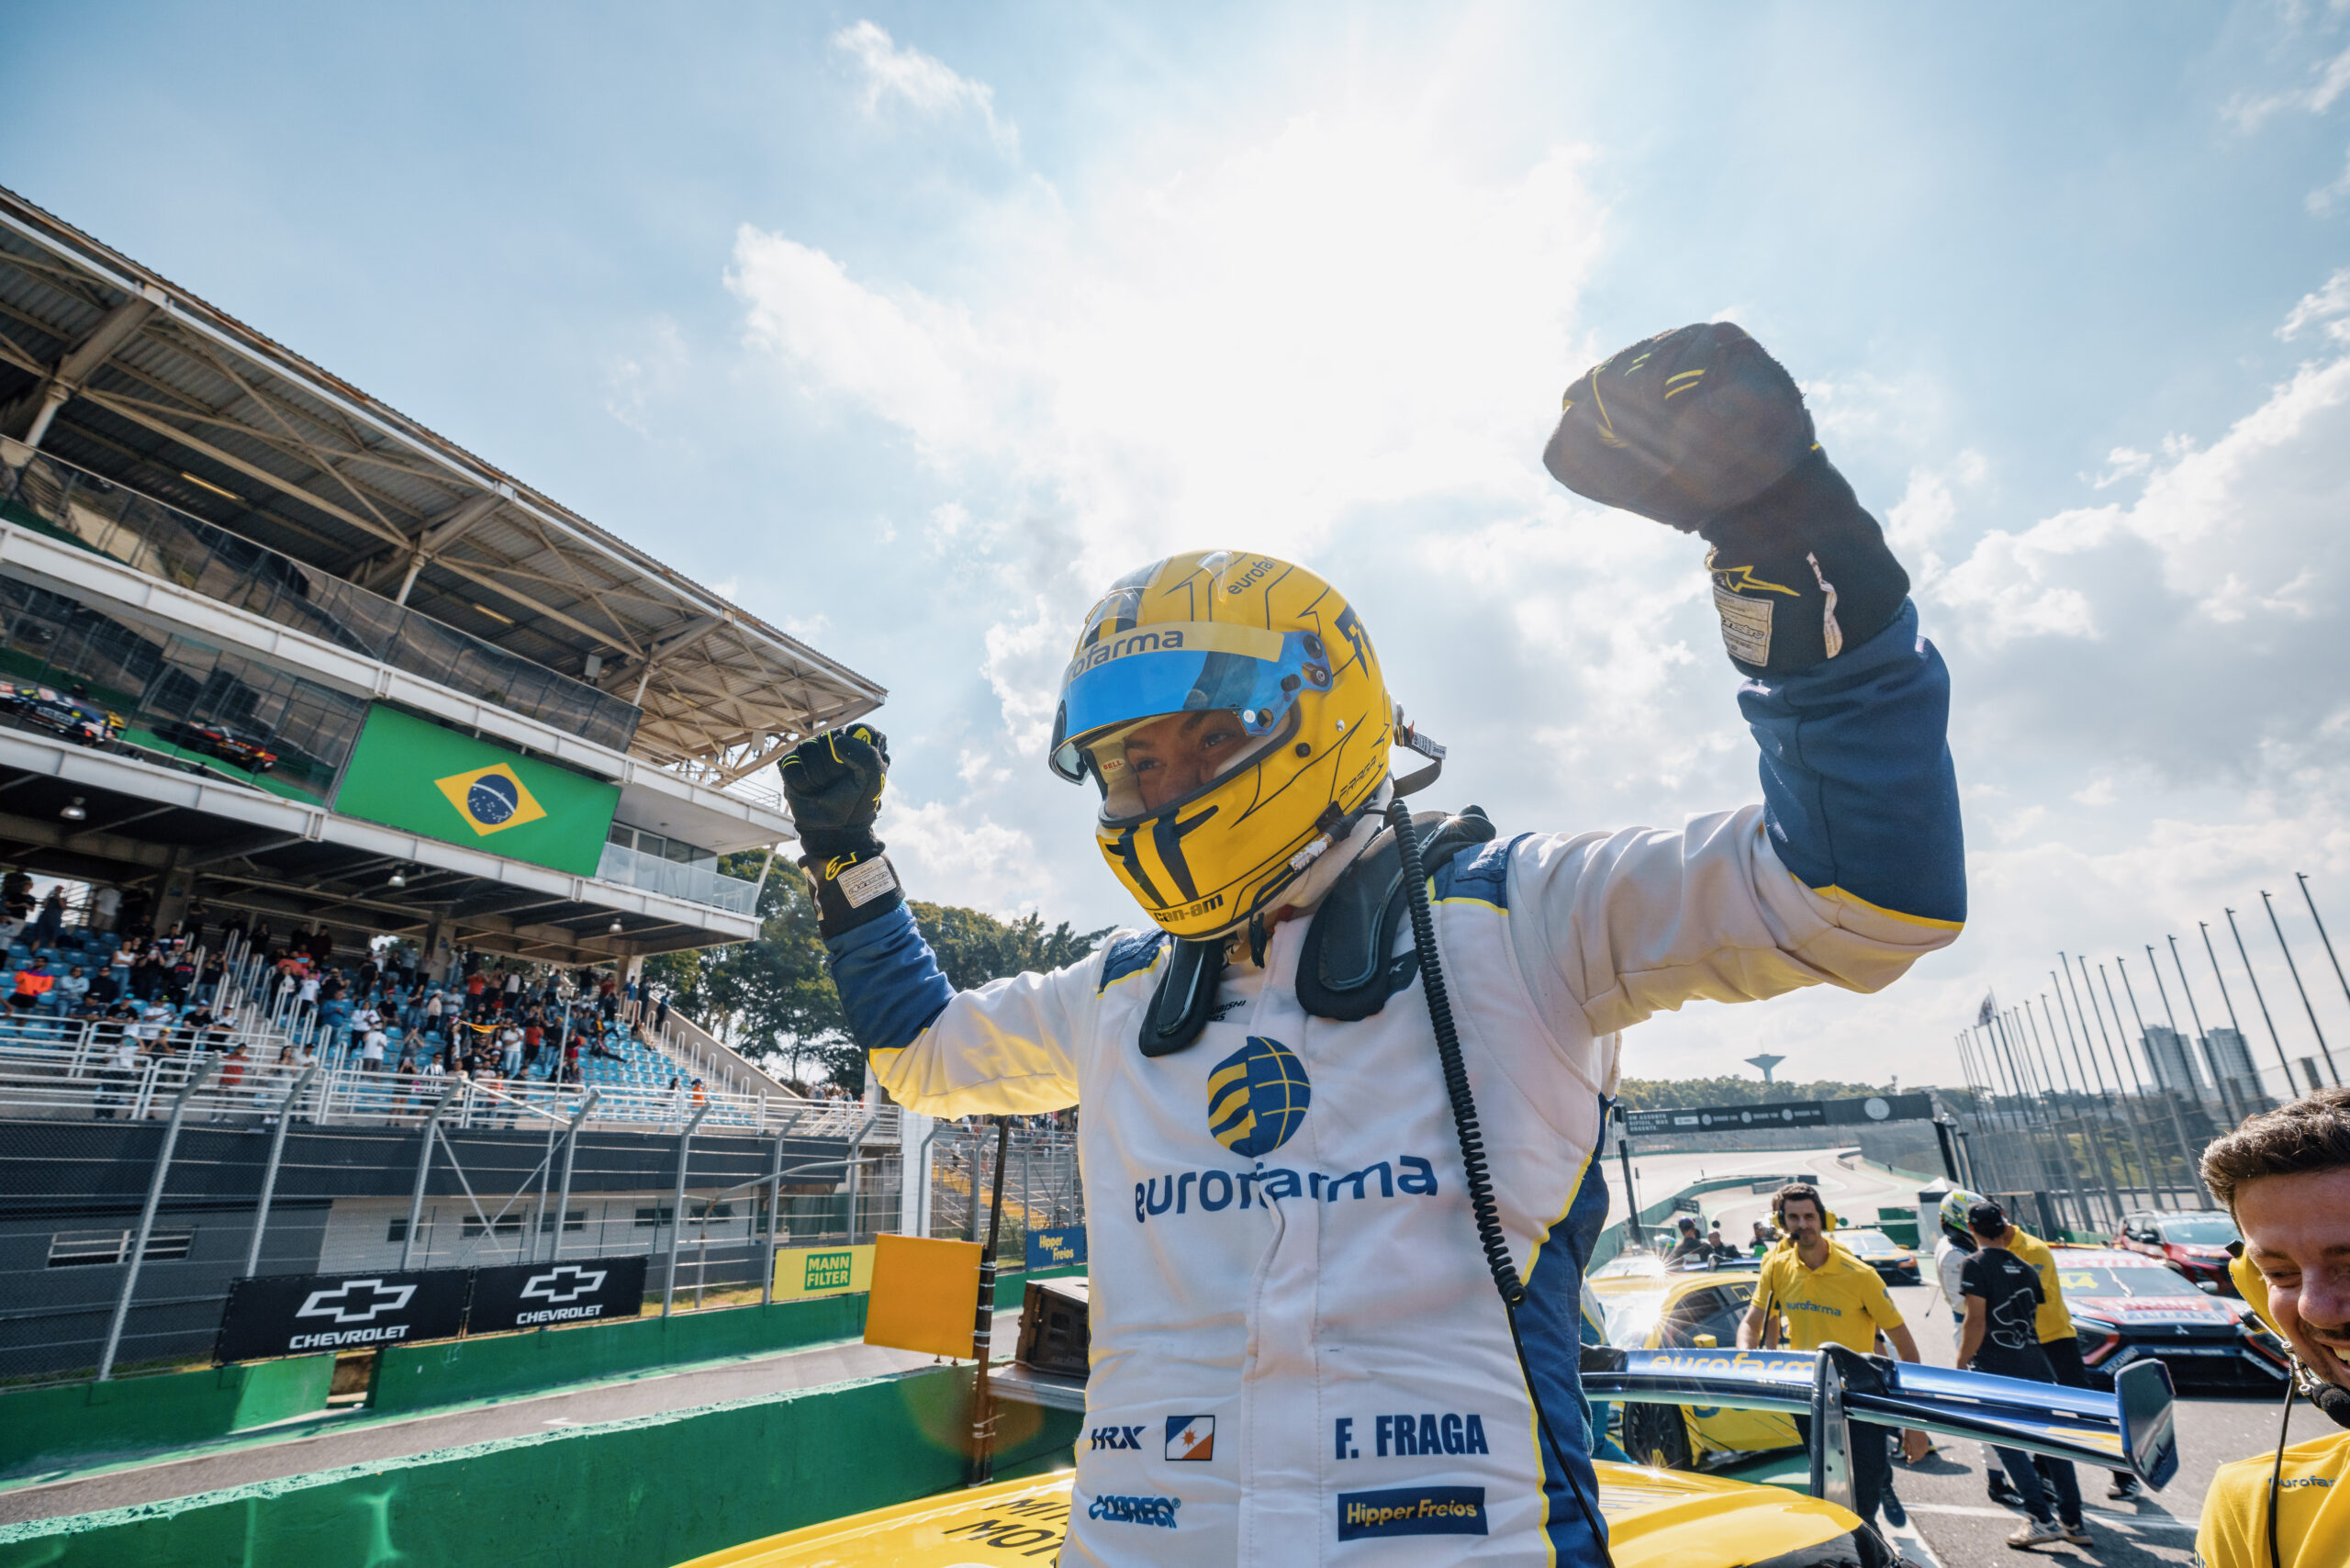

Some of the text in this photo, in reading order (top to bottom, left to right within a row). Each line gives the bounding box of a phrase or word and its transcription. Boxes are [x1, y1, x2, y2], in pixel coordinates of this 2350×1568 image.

[1154, 893, 1225, 923] can-am
[1135, 1154, 1438, 1223] eurofarma
[809, 1255, 850, 1271] MANN
[807, 1271, 848, 1287] FILTER
[516, 1305, 603, 1325] CHEVROLET
[1786, 1300, 1842, 1317] eurofarma
[289, 1325, 409, 1350] CHEVROLET
[1091, 1426, 1147, 1450] HRX
[1335, 1413, 1490, 1460] F. FRAGA
[2268, 1475, 2337, 1488] urofar
[1347, 1499, 1477, 1527] Hipper Freios
